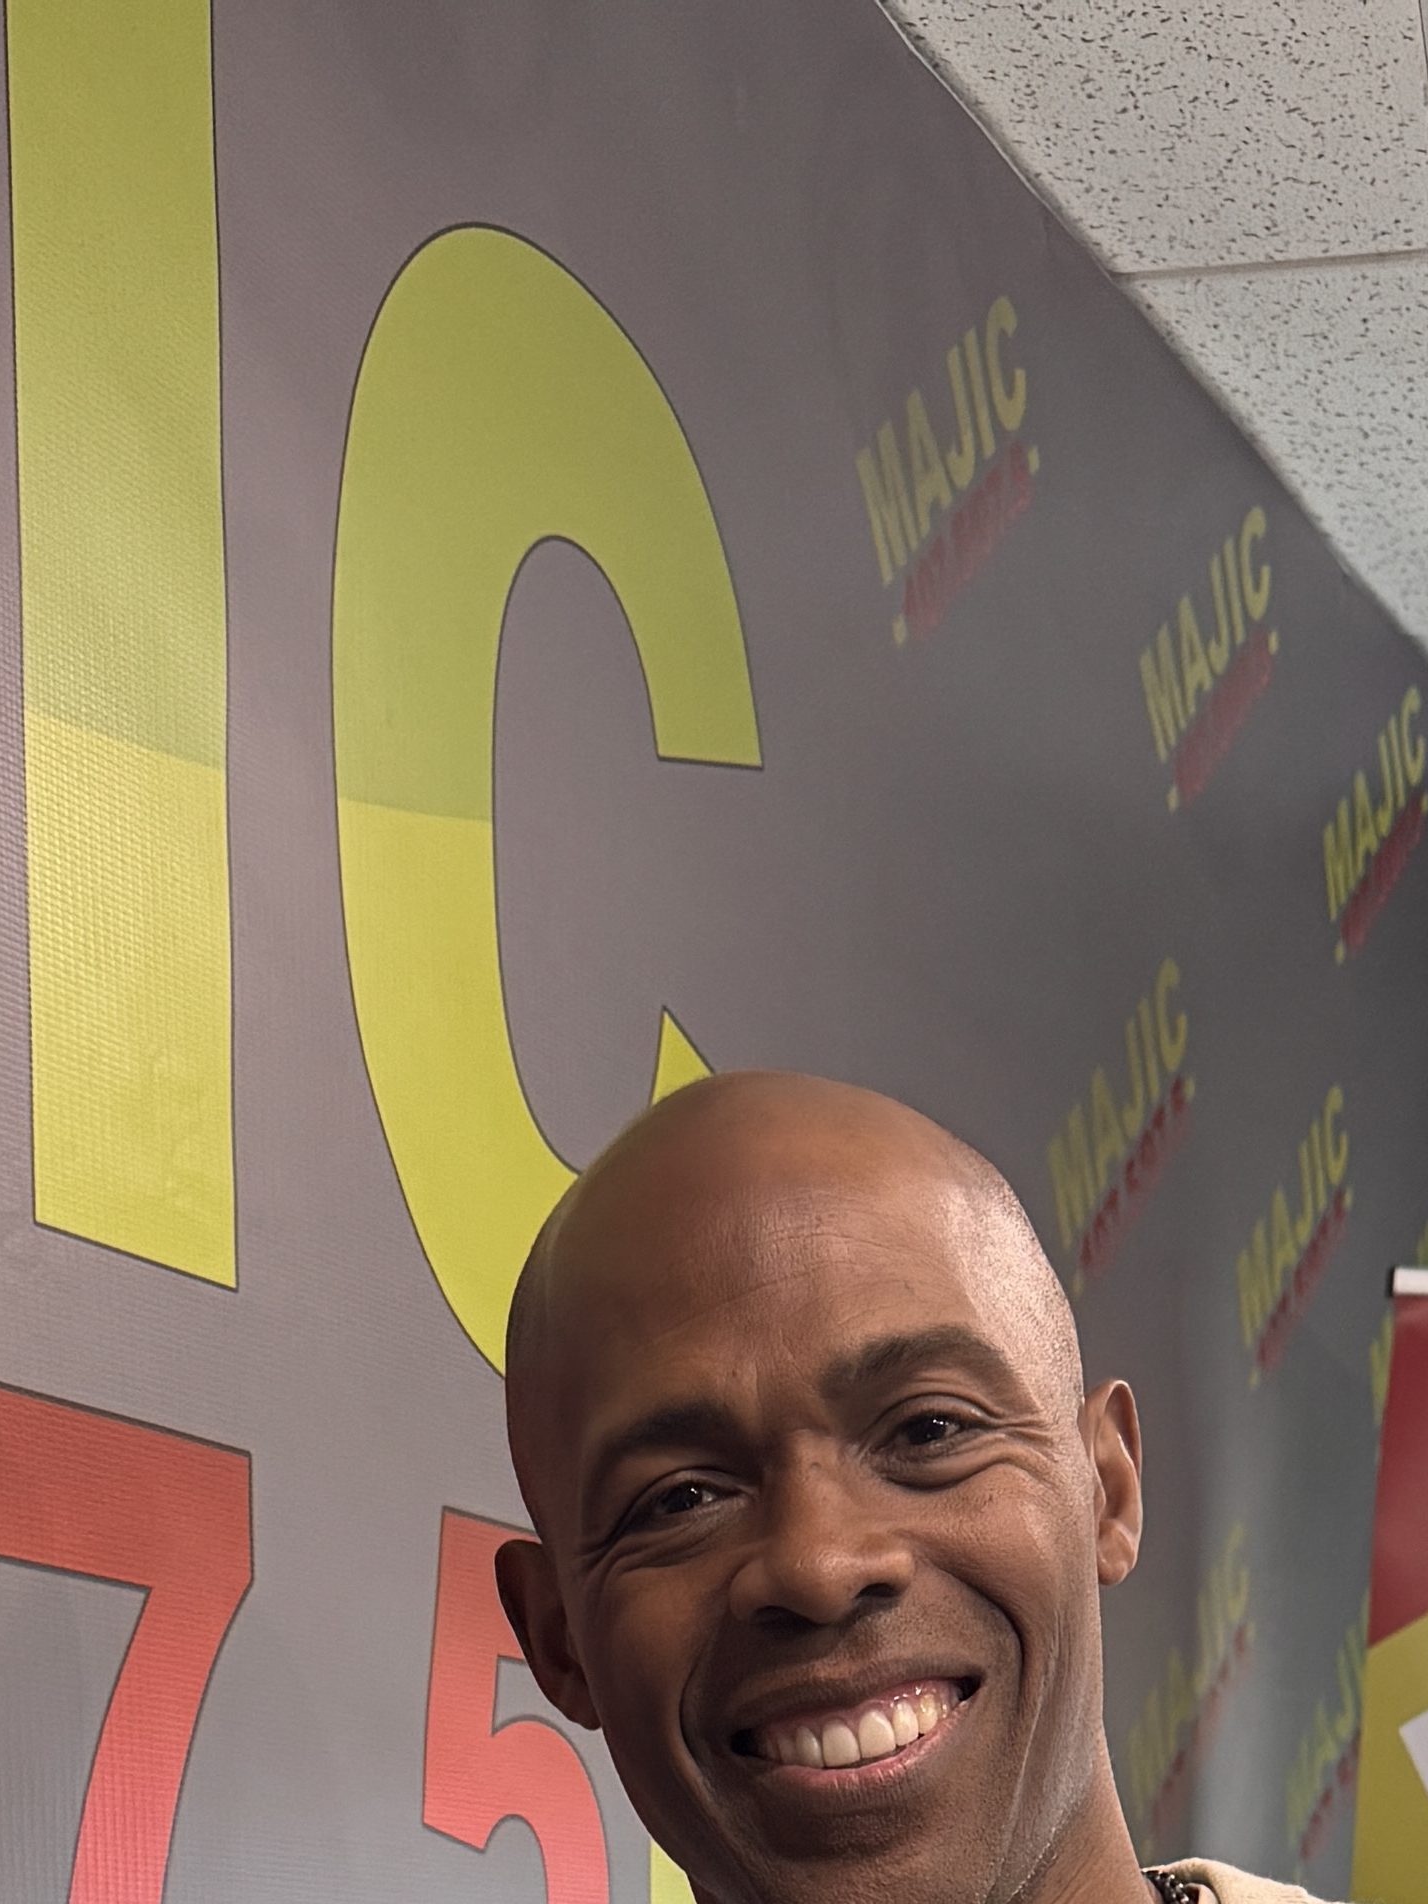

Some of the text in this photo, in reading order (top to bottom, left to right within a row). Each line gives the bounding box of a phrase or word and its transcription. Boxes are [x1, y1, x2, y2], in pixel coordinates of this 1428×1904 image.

[856, 296, 1027, 586] MAJIC
[1139, 505, 1271, 764] MAJIC
[1321, 685, 1426, 923] MAJIC
[1047, 956, 1189, 1252] MAJIC
[1235, 1083, 1350, 1347] MAJIC
